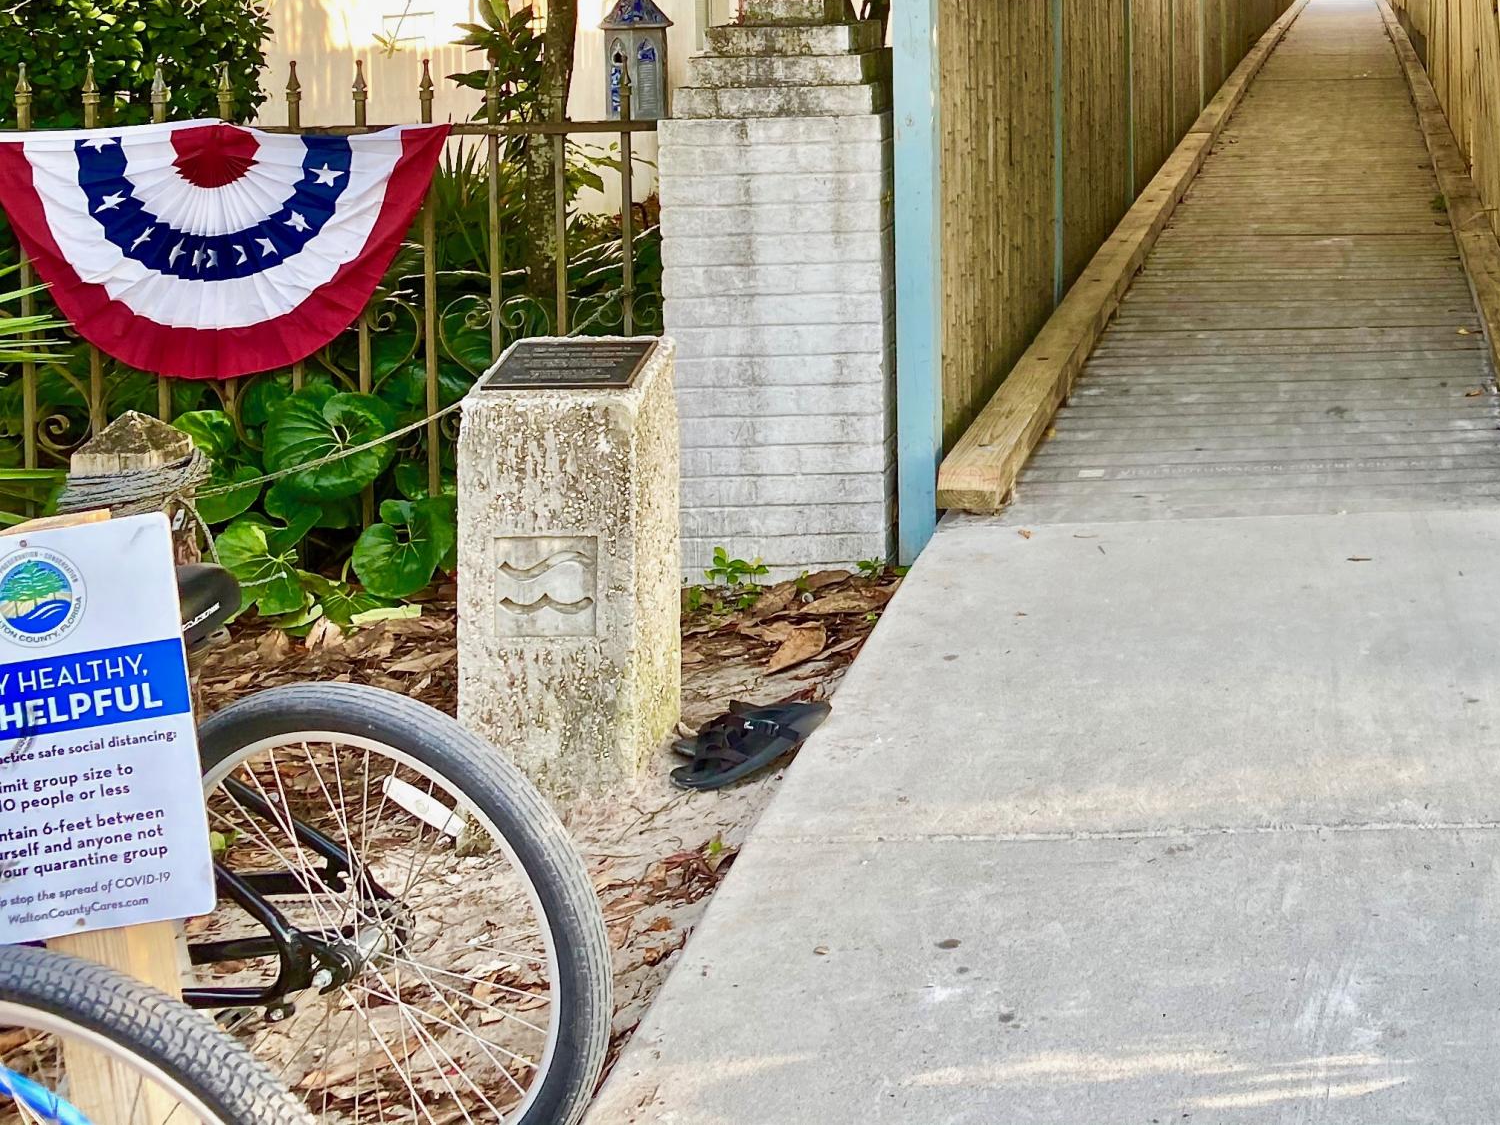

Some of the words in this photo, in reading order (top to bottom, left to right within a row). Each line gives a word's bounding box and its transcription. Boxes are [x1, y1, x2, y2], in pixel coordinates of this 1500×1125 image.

[60, 596, 82, 633] FLORIDA
[18, 653, 148, 693] HEALTHY,
[0, 682, 163, 731] HELPFUL
[38, 745, 65, 759] safe
[68, 738, 105, 755] social
[108, 730, 177, 749] distancing:
[33, 774, 78, 793] group
[83, 767, 113, 782] size
[117, 763, 134, 777] to
[21, 790, 74, 813] people
[79, 789, 96, 801] or
[100, 783, 130, 799] less
[42, 819, 92, 837] 6-feet
[96, 808, 165, 828] between
[44, 837, 73, 855] and
[77, 831, 133, 850] anyone
[137, 824, 164, 841] not
[33, 852, 119, 877] quarantine
[123, 845, 169, 864] group
[10, 894, 35, 906] stop
[37, 890, 56, 902] the
[59, 881, 98, 899] spread
[101, 878, 113, 894] of
[115, 871, 171, 890] COVID-19
[8, 896, 149, 925] WaltonCountyCares.com
